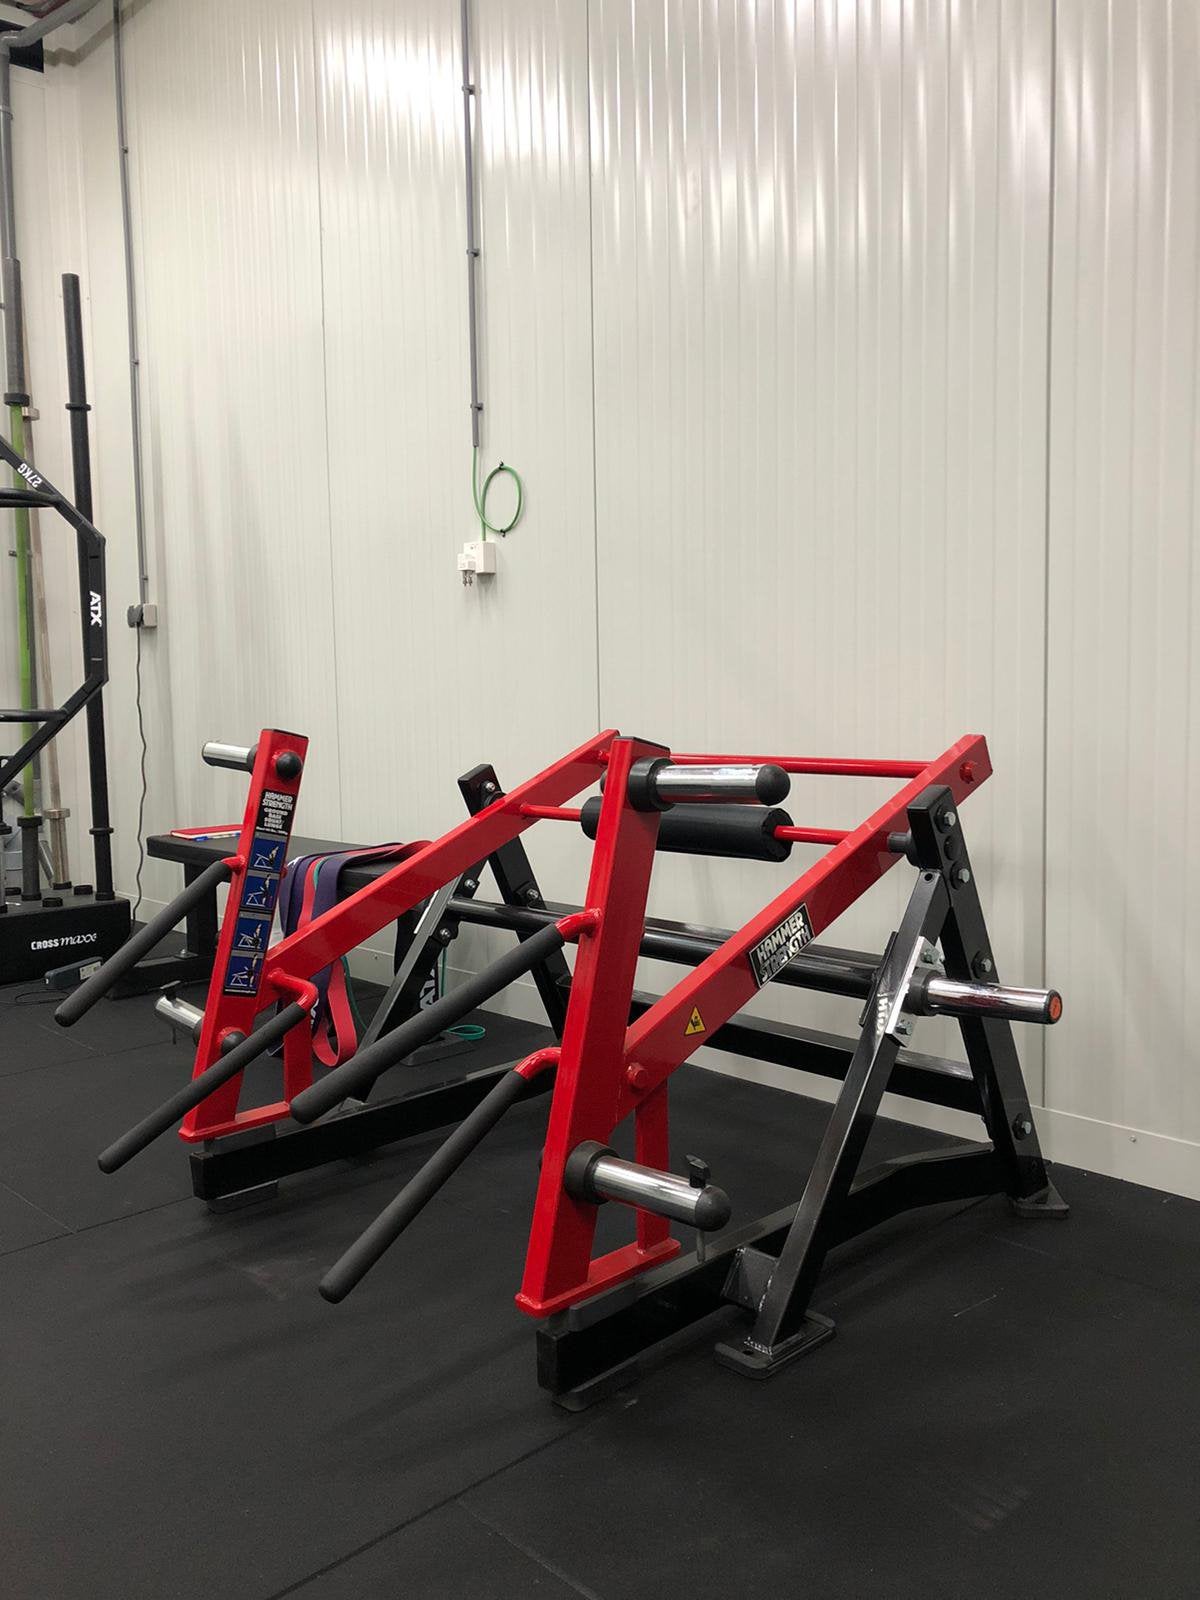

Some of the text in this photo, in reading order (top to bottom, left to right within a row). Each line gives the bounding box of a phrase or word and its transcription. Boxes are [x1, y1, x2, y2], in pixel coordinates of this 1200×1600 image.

[17, 463, 42, 488] 27KG
[89, 590, 102, 627] ATX
[756, 911, 804, 964] HAMMER
[760, 924, 811, 982] STRENGTH
